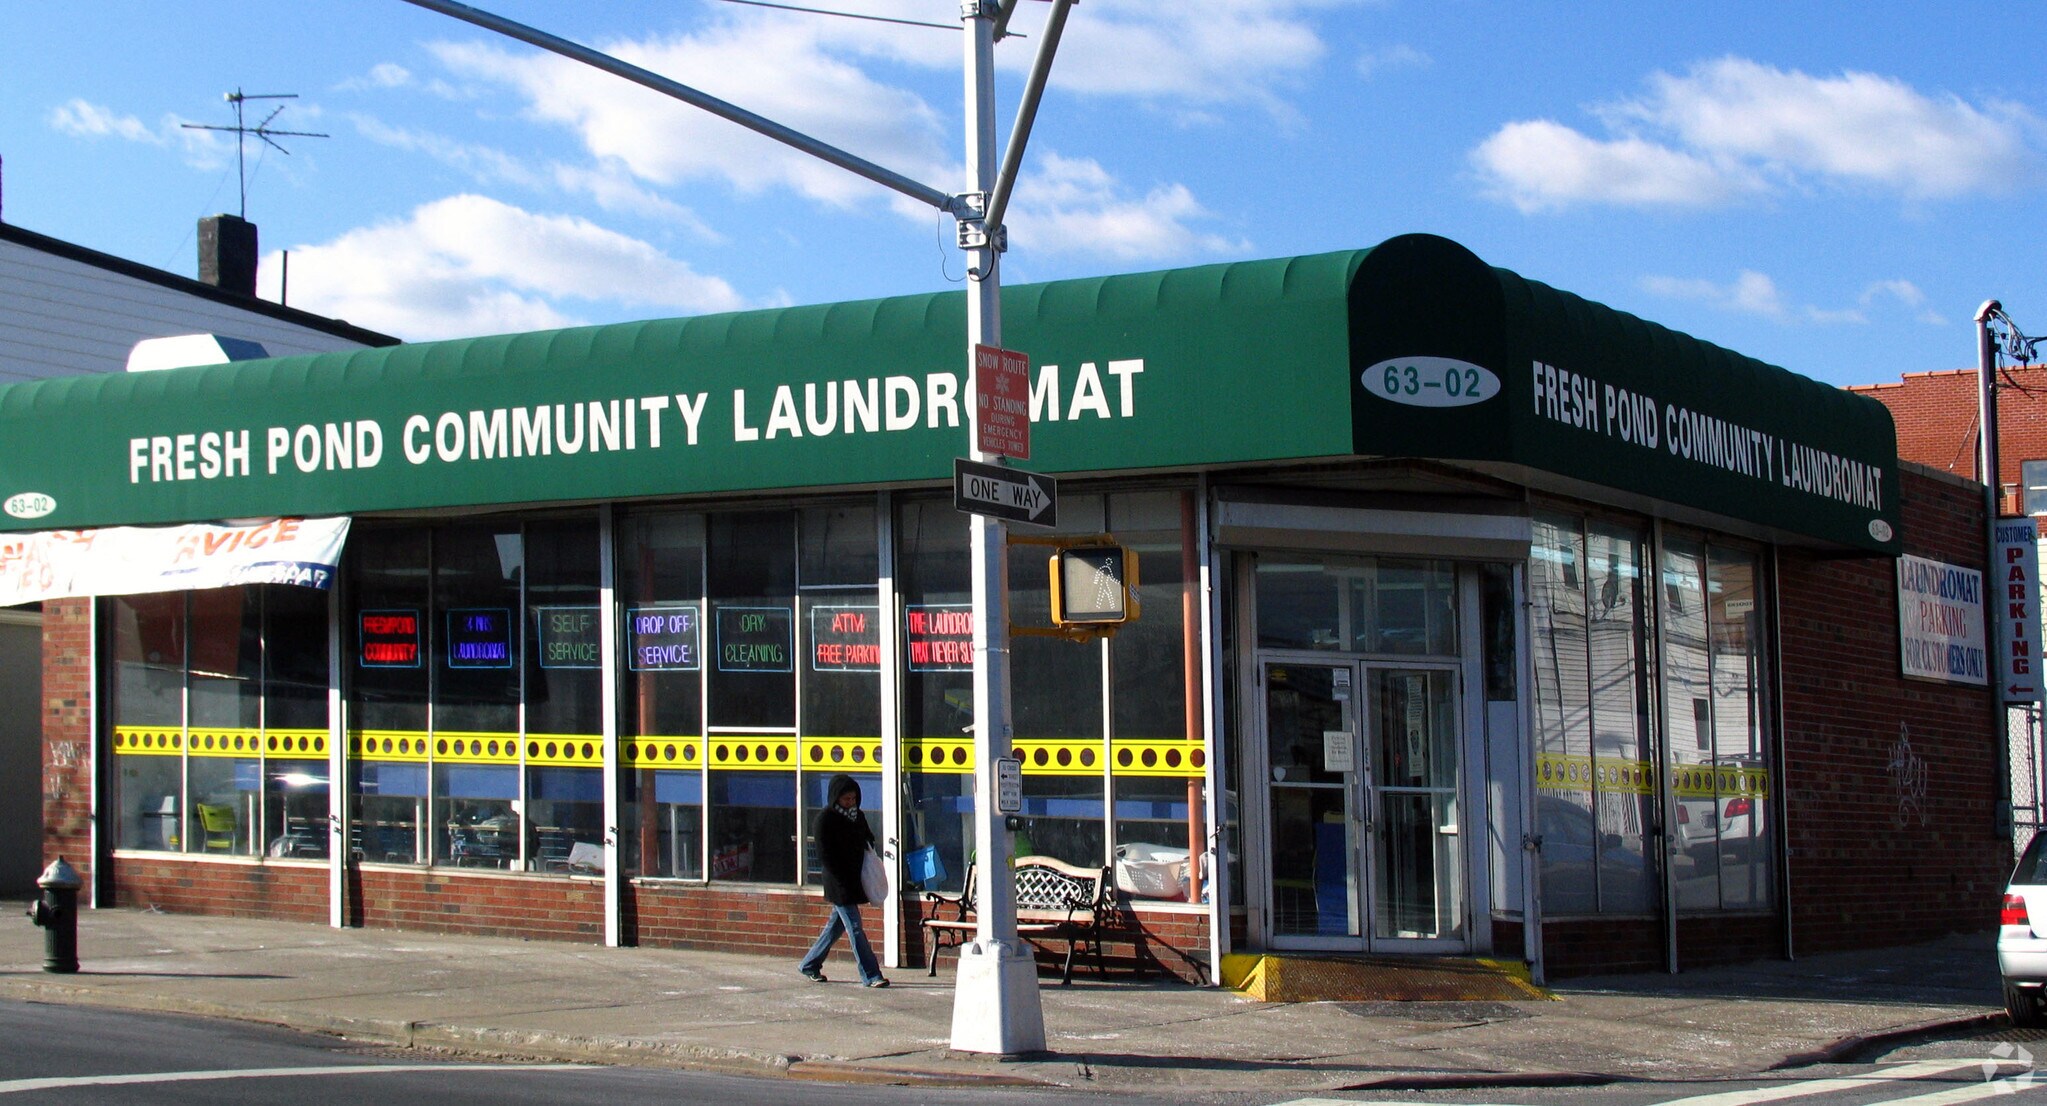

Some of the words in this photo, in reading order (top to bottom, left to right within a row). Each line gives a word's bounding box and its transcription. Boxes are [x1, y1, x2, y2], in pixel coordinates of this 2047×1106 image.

[978, 352, 998, 370] SNOW
[1003, 357, 1026, 376] ROUTE
[1383, 365, 1480, 397] 63-02
[978, 392, 989, 409] NO
[993, 395, 1027, 417] STANDING
[129, 429, 250, 484] FRESH
[267, 419, 383, 475] POND
[403, 392, 709, 465] COMMUNITY
[733, 358, 1145, 442] LAUNDRMAT
[991, 412, 1015, 427] DURING
[983, 423, 1022, 440] EMERGENCY
[1532, 360, 1599, 433] FRESH
[1604, 383, 1659, 449] POND
[1665, 403, 1773, 482] COMMUNITY
[1780, 438, 1881, 511] LAUNDROMAT
[983, 436, 1006, 450] VEHICLES
[970, 478, 1000, 501] ONE
[1012, 485, 1041, 509] WAY
[11, 496, 48, 514] 63-02
[1995, 525, 2033, 545] CUSTOMER
[1901, 557, 1979, 605] LAUNDROMAT
[1920, 600, 1967, 639] PARKING
[2006, 547, 2030, 675] PARKING
[552, 614, 589, 634] SELF
[635, 615, 665, 635] DROP
[669, 614, 690, 634] OFF
[741, 614, 766, 633] DRY
[832, 613, 865, 634] ATM
[908, 612, 927, 635] THE
[929, 612, 974, 635] LAUNDRO
[548, 642, 598, 662] SERVICE
[638, 644, 691, 665] SERVICE
[724, 643, 784, 663] CLEANING
[817, 643, 843, 664] FREE
[845, 643, 881, 664] PARKIN
[910, 641, 928, 663] THAT
[932, 641, 959, 663] NEVER
[1905, 637, 1920, 670] FOR
[1922, 639, 1965, 676] CUSTOMERS
[1966, 647, 1984, 679] ONLY
